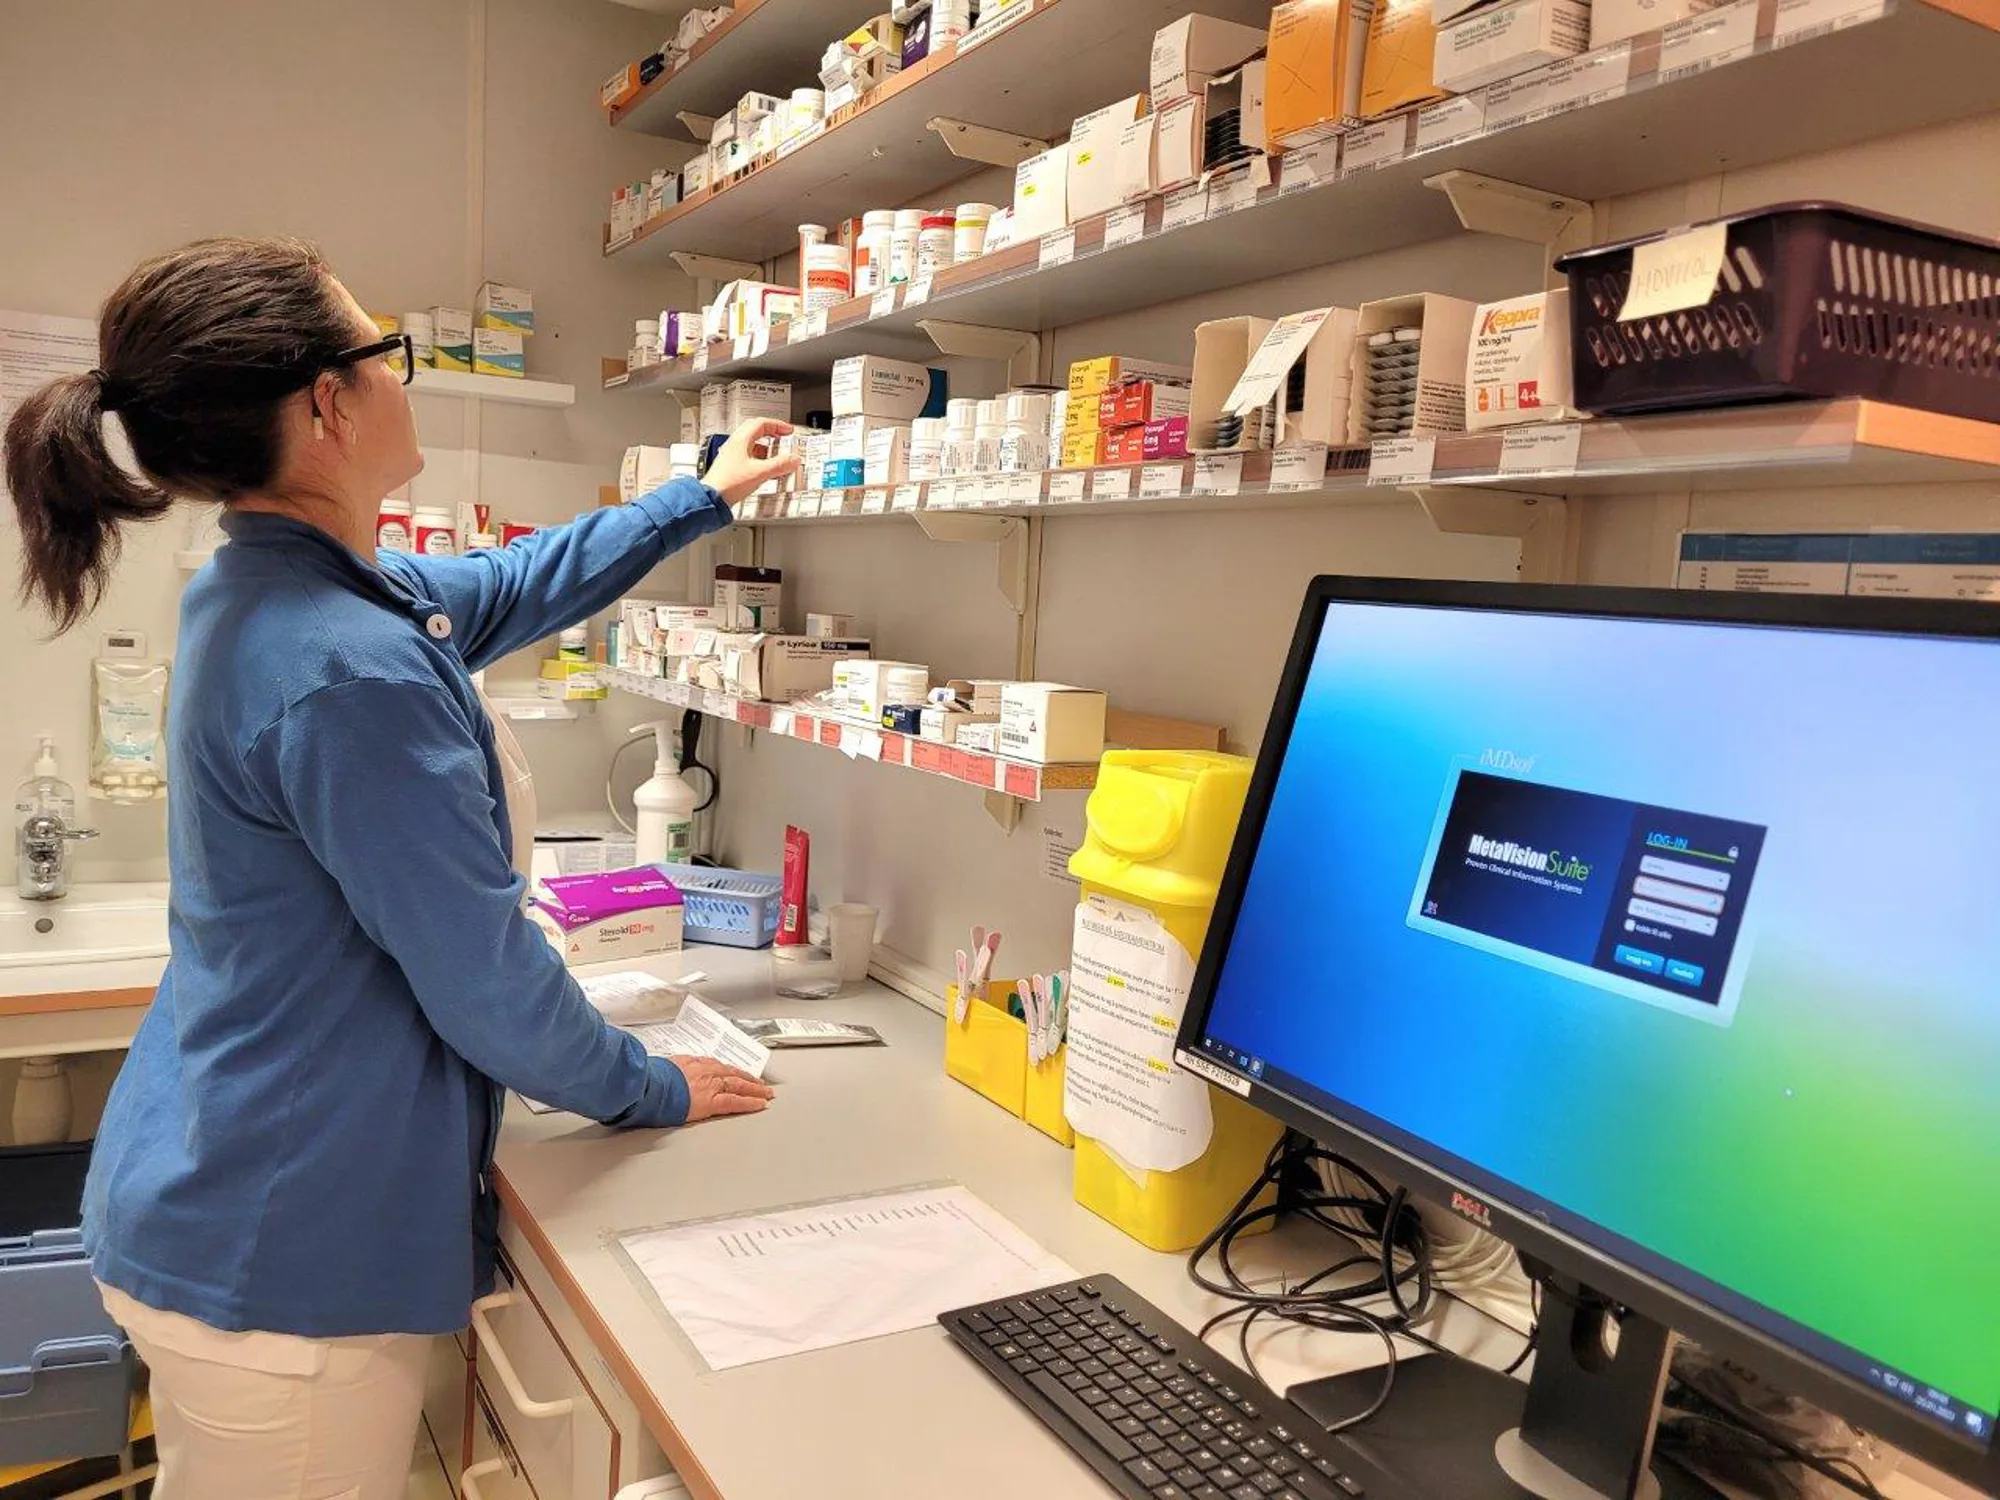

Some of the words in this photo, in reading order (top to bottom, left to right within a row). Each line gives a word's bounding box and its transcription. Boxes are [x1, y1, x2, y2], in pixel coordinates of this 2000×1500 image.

[1480, 307, 1541, 336] Keppra
[1520, 387, 1539, 402] 4+
[1646, 831, 1688, 849] LOG-IN
[1465, 857, 1488, 870] Proven
[1488, 863, 1512, 876] Clinical
[1511, 869, 1553, 887] Information
[1553, 879, 1582, 895] Systems
